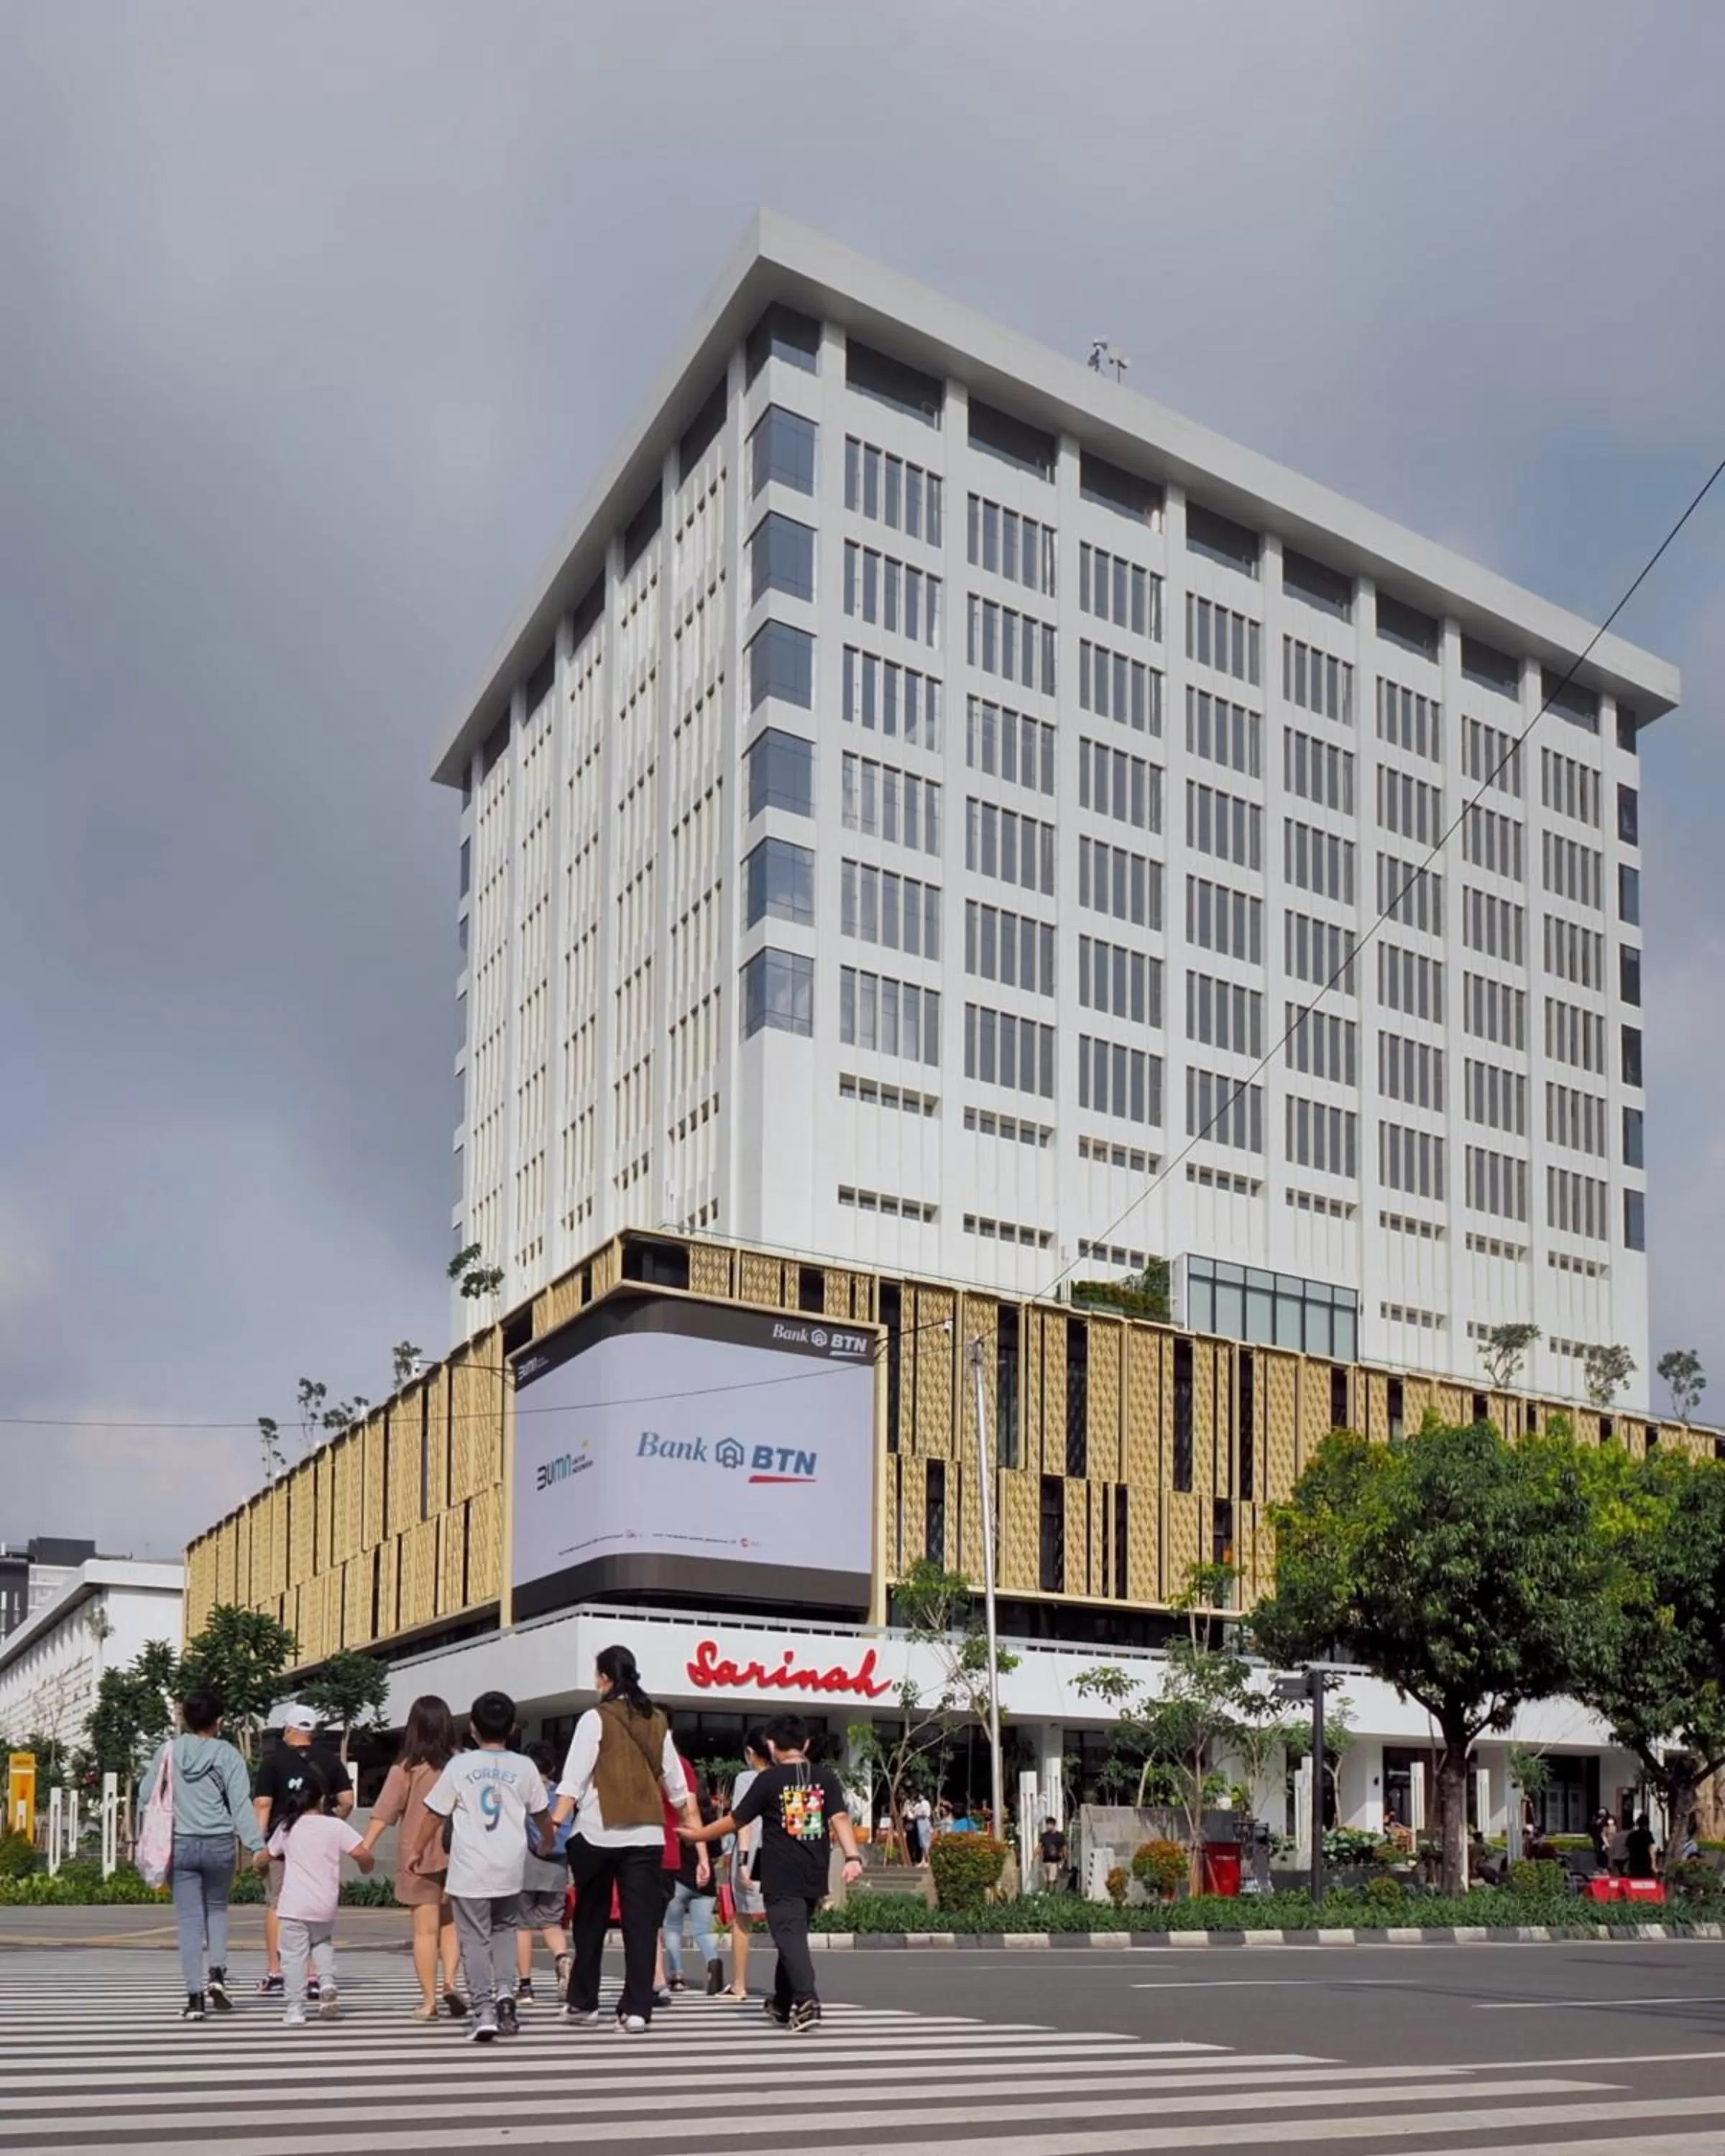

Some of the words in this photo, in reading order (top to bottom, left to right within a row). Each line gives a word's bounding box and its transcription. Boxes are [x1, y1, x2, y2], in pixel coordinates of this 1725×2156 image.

[773, 1323, 809, 1343] Bank
[830, 1333, 867, 1352] BTN
[636, 1431, 708, 1463] Bank
[751, 1445, 816, 1475] BTN
[686, 1641, 893, 1698] Sarinah
[465, 1767, 518, 1784] TORRES
[481, 1786, 501, 1833] 9
